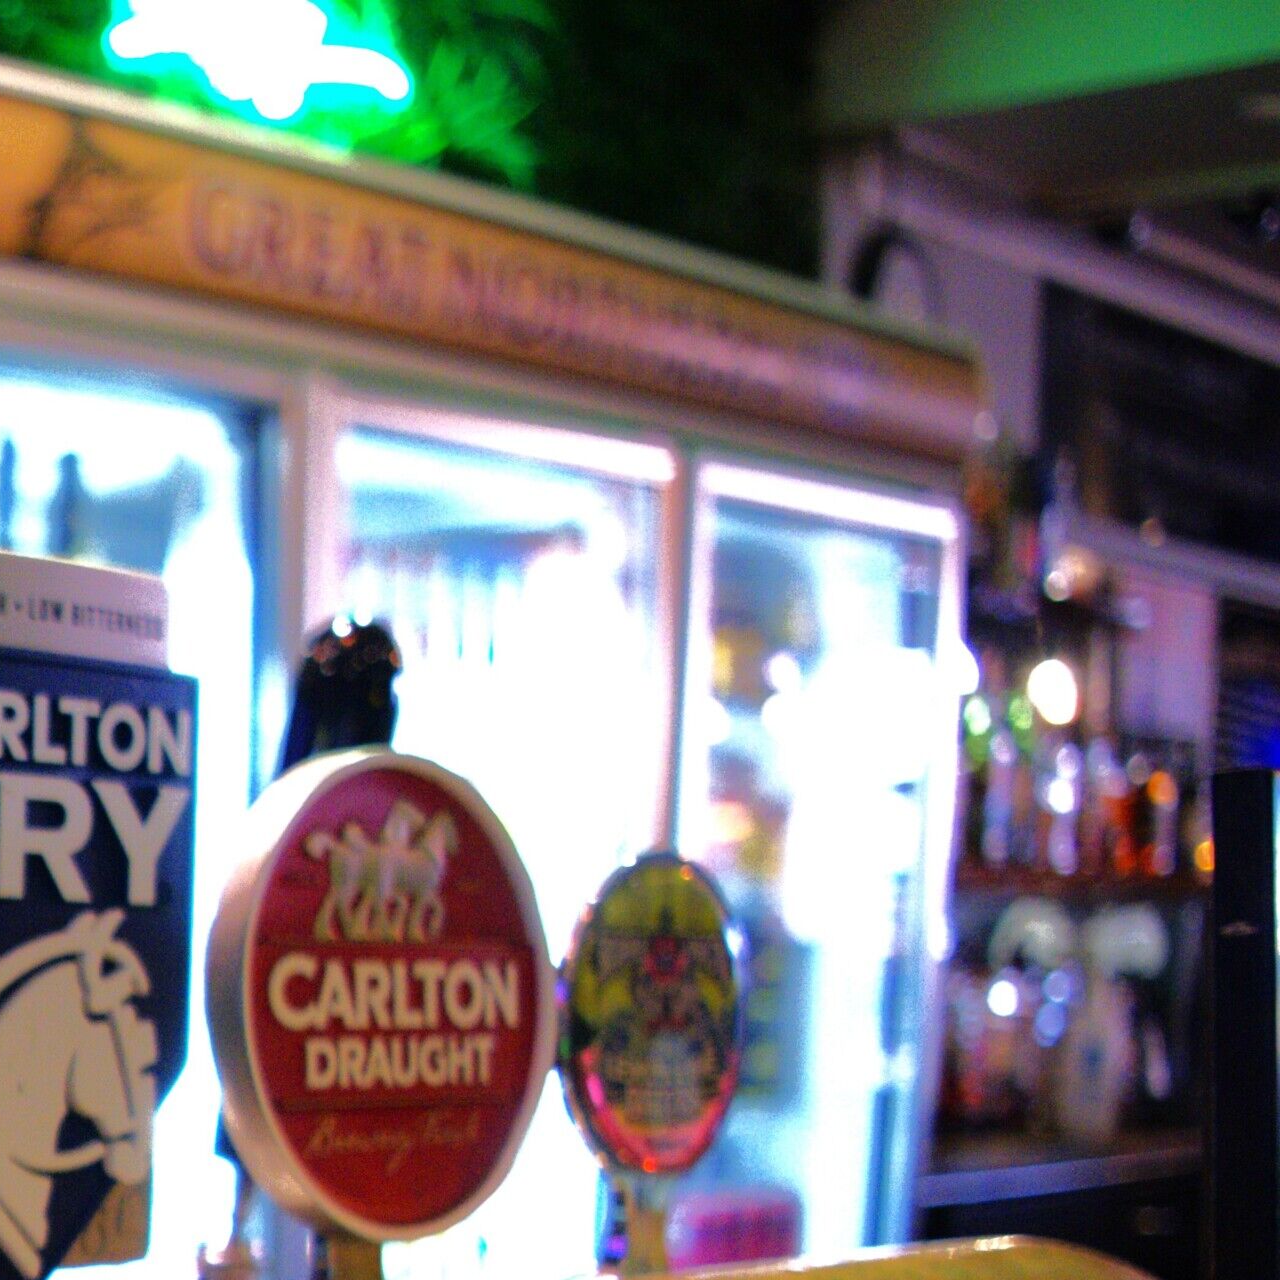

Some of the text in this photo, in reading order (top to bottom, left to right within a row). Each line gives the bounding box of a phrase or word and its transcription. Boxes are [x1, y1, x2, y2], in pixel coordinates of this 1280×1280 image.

[27, 595, 65, 624] LOW
[267, 951, 520, 1031] CARLTON
[304, 1035, 493, 1090] DRAUGHT
